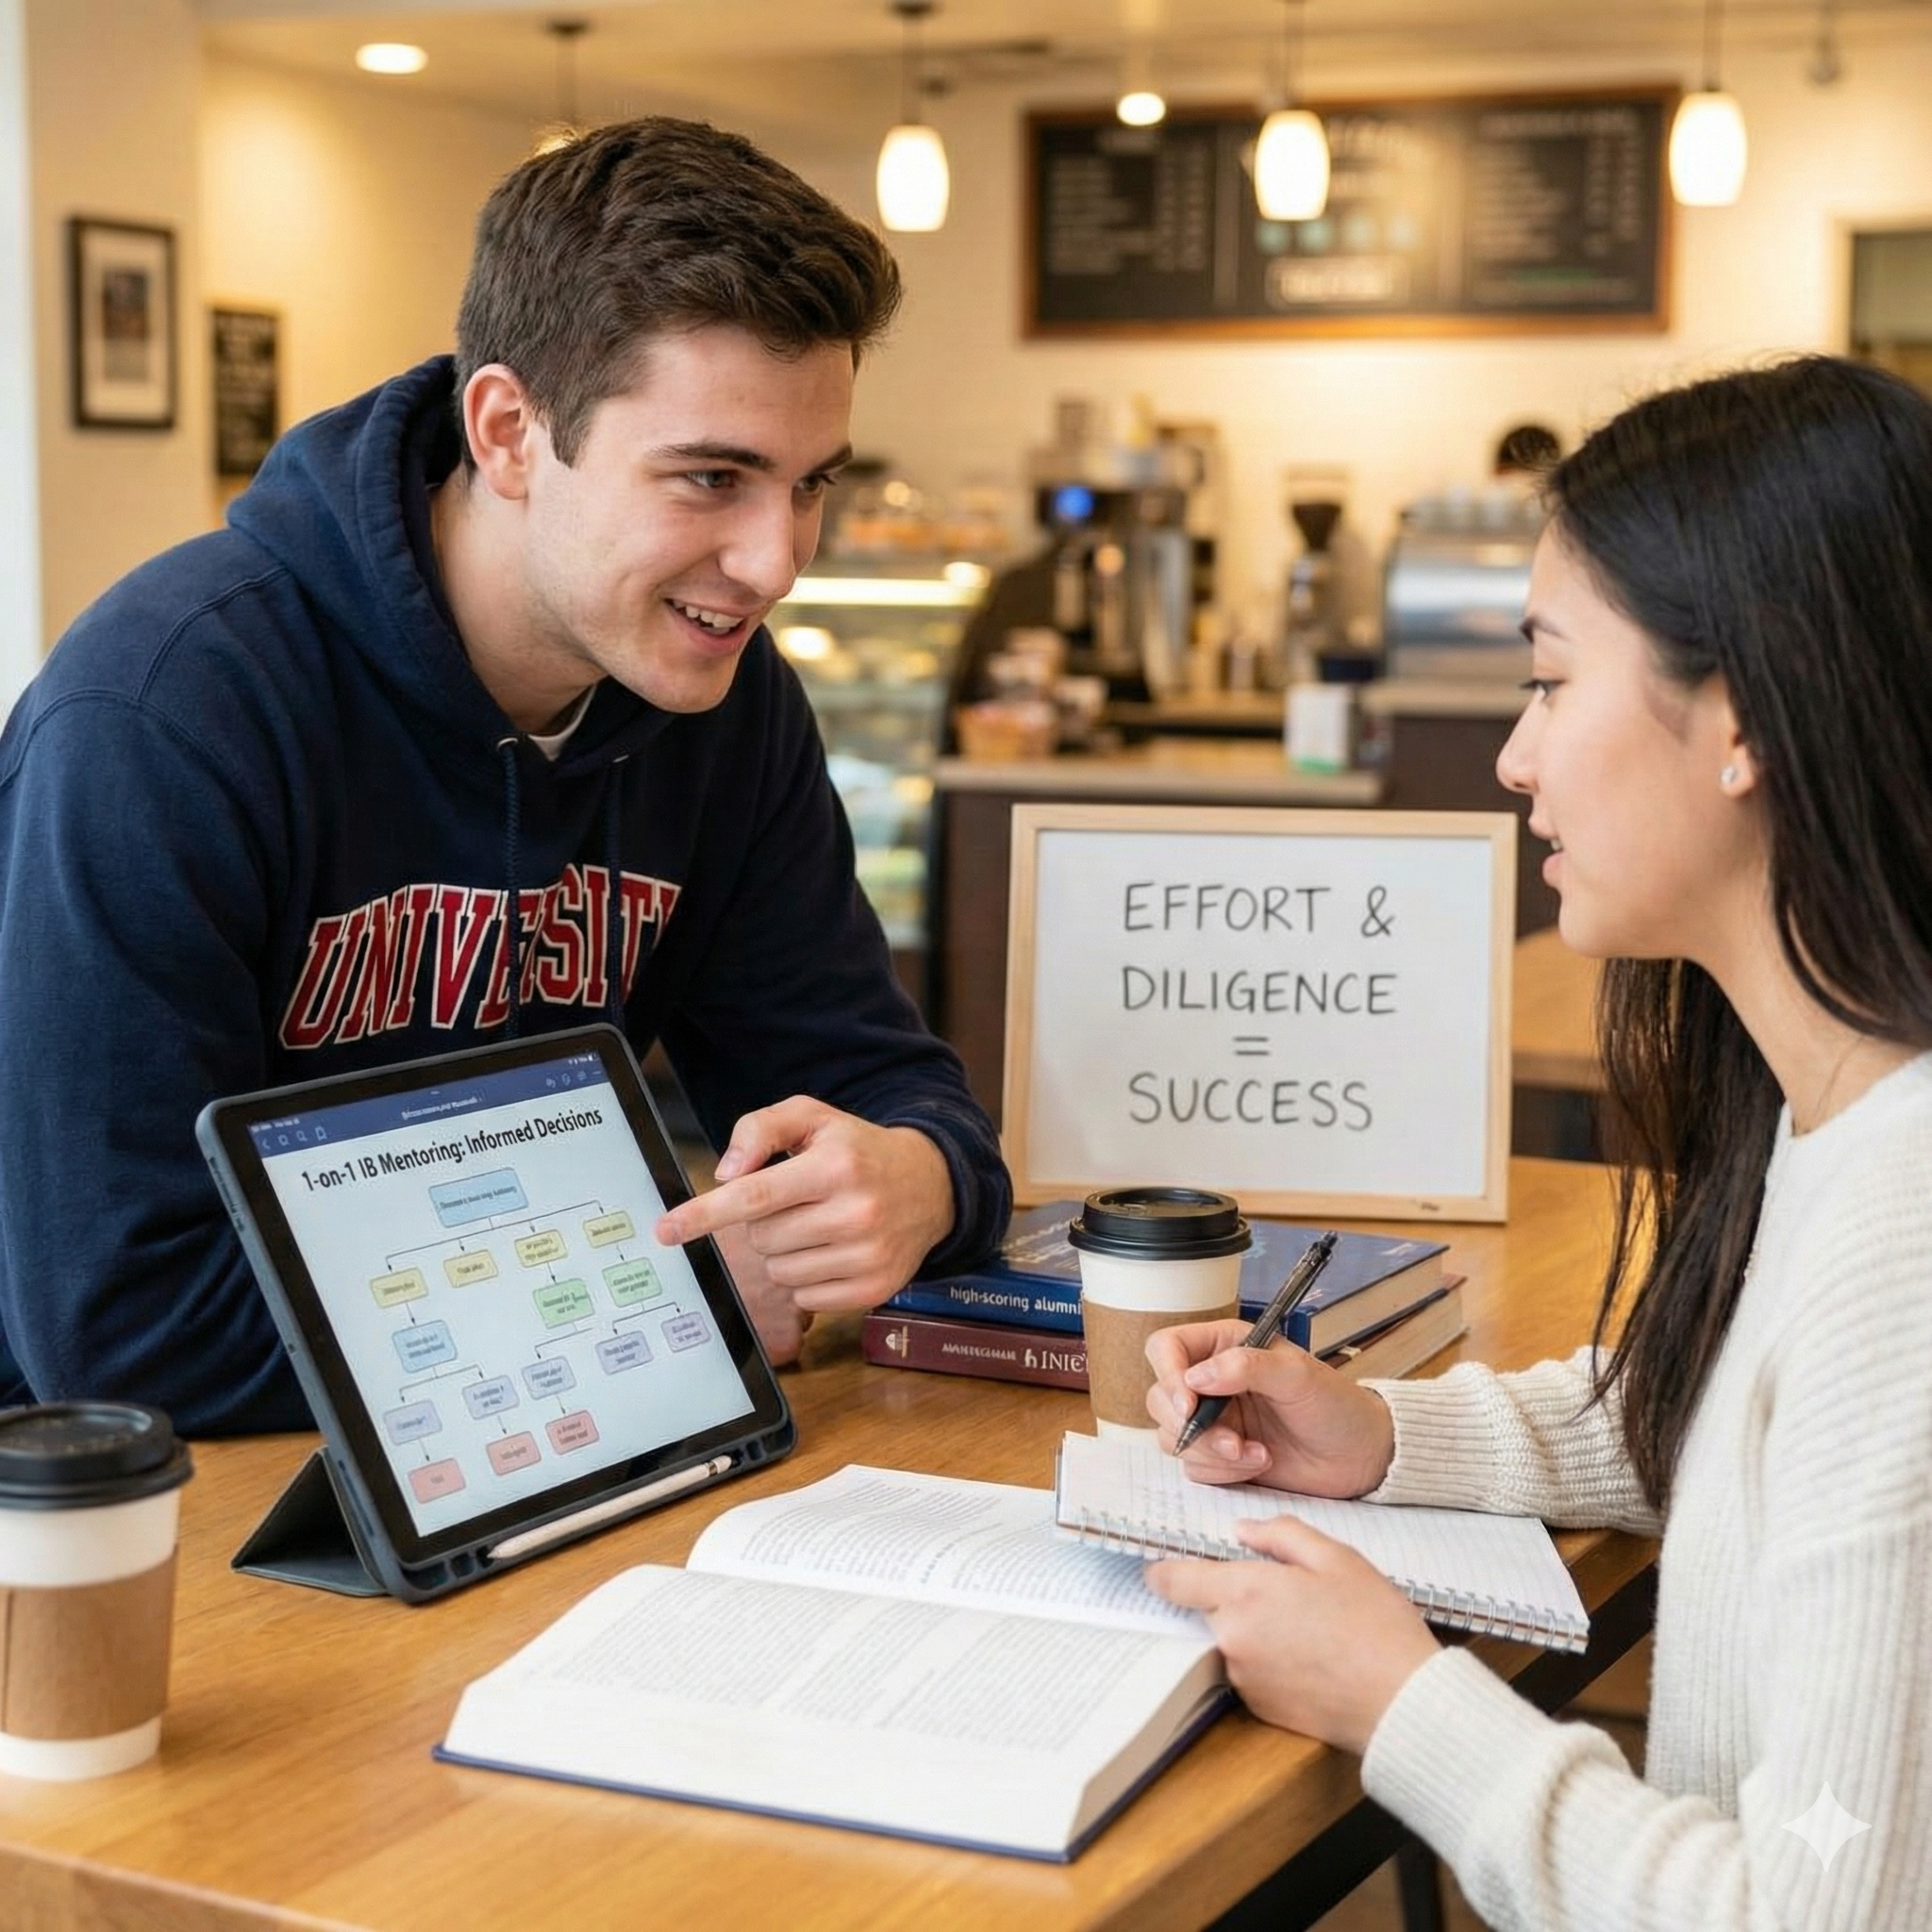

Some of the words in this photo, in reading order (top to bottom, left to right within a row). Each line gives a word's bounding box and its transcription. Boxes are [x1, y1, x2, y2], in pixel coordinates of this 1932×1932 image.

[1124, 881, 1331, 933] EFFORT
[1360, 885, 1396, 938] &
[278, 862, 682, 1050] UNIVESIT
[1122, 965, 1397, 1015] DILIGENCE
[1128, 1071, 1373, 1131] SUCCESS
[301, 1160, 357, 1191] 1-on-1
[358, 1157, 378, 1179] IB
[377, 1141, 466, 1174] Mentoring:
[464, 1121, 535, 1155] Informed
[533, 1107, 603, 1136] Decisions
[950, 1286, 1029, 1312] high-scoring
[1034, 1296, 1082, 1315] alumni
